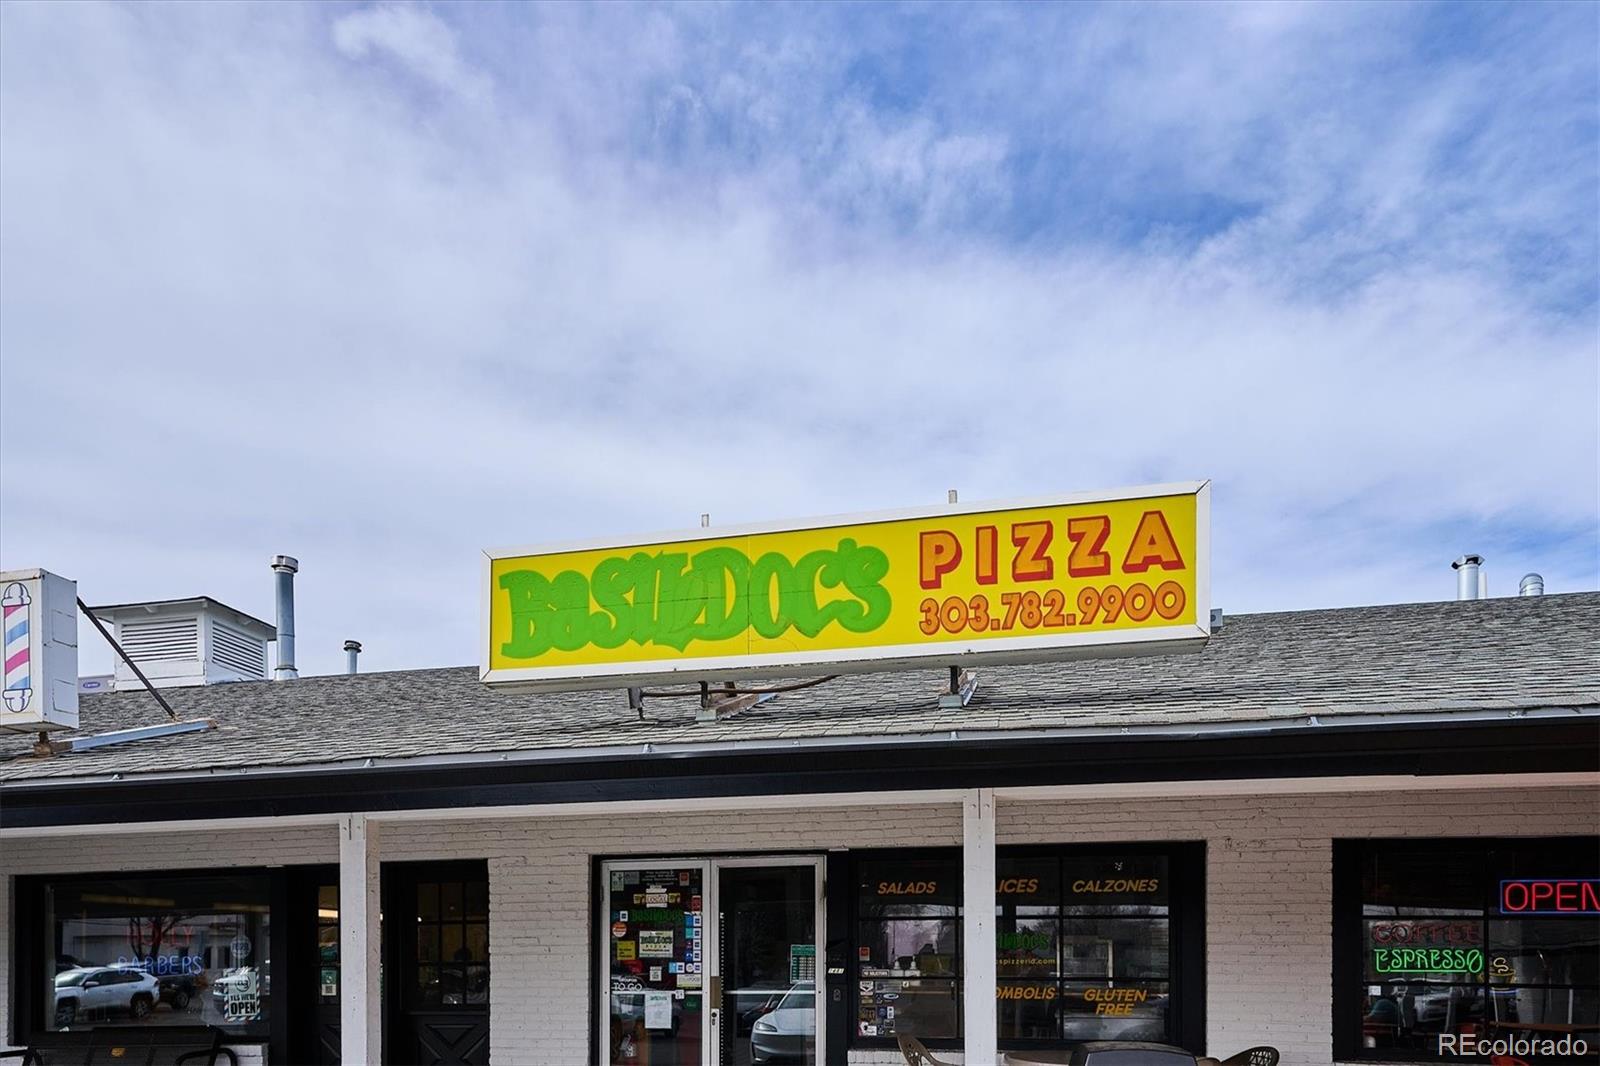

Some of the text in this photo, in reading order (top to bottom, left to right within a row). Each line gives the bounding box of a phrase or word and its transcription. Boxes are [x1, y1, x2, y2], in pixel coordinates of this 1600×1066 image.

[920, 510, 1183, 589] PIZZA
[920, 581, 1185, 636] 303.782.9900
[878, 881, 936, 895] SALADS
[996, 879, 1038, 894] ICES
[1072, 879, 1159, 894] CALZONES
[1372, 923, 1480, 944] COFFEE
[117, 955, 202, 975] BARBERS
[1374, 948, 1483, 973] ESPRESSO
[613, 982, 643, 992] TO GO
[1084, 988, 1147, 1002] GLUTEN
[230, 1002, 256, 1015] OPEN
[1095, 1003, 1135, 1017] FREE
